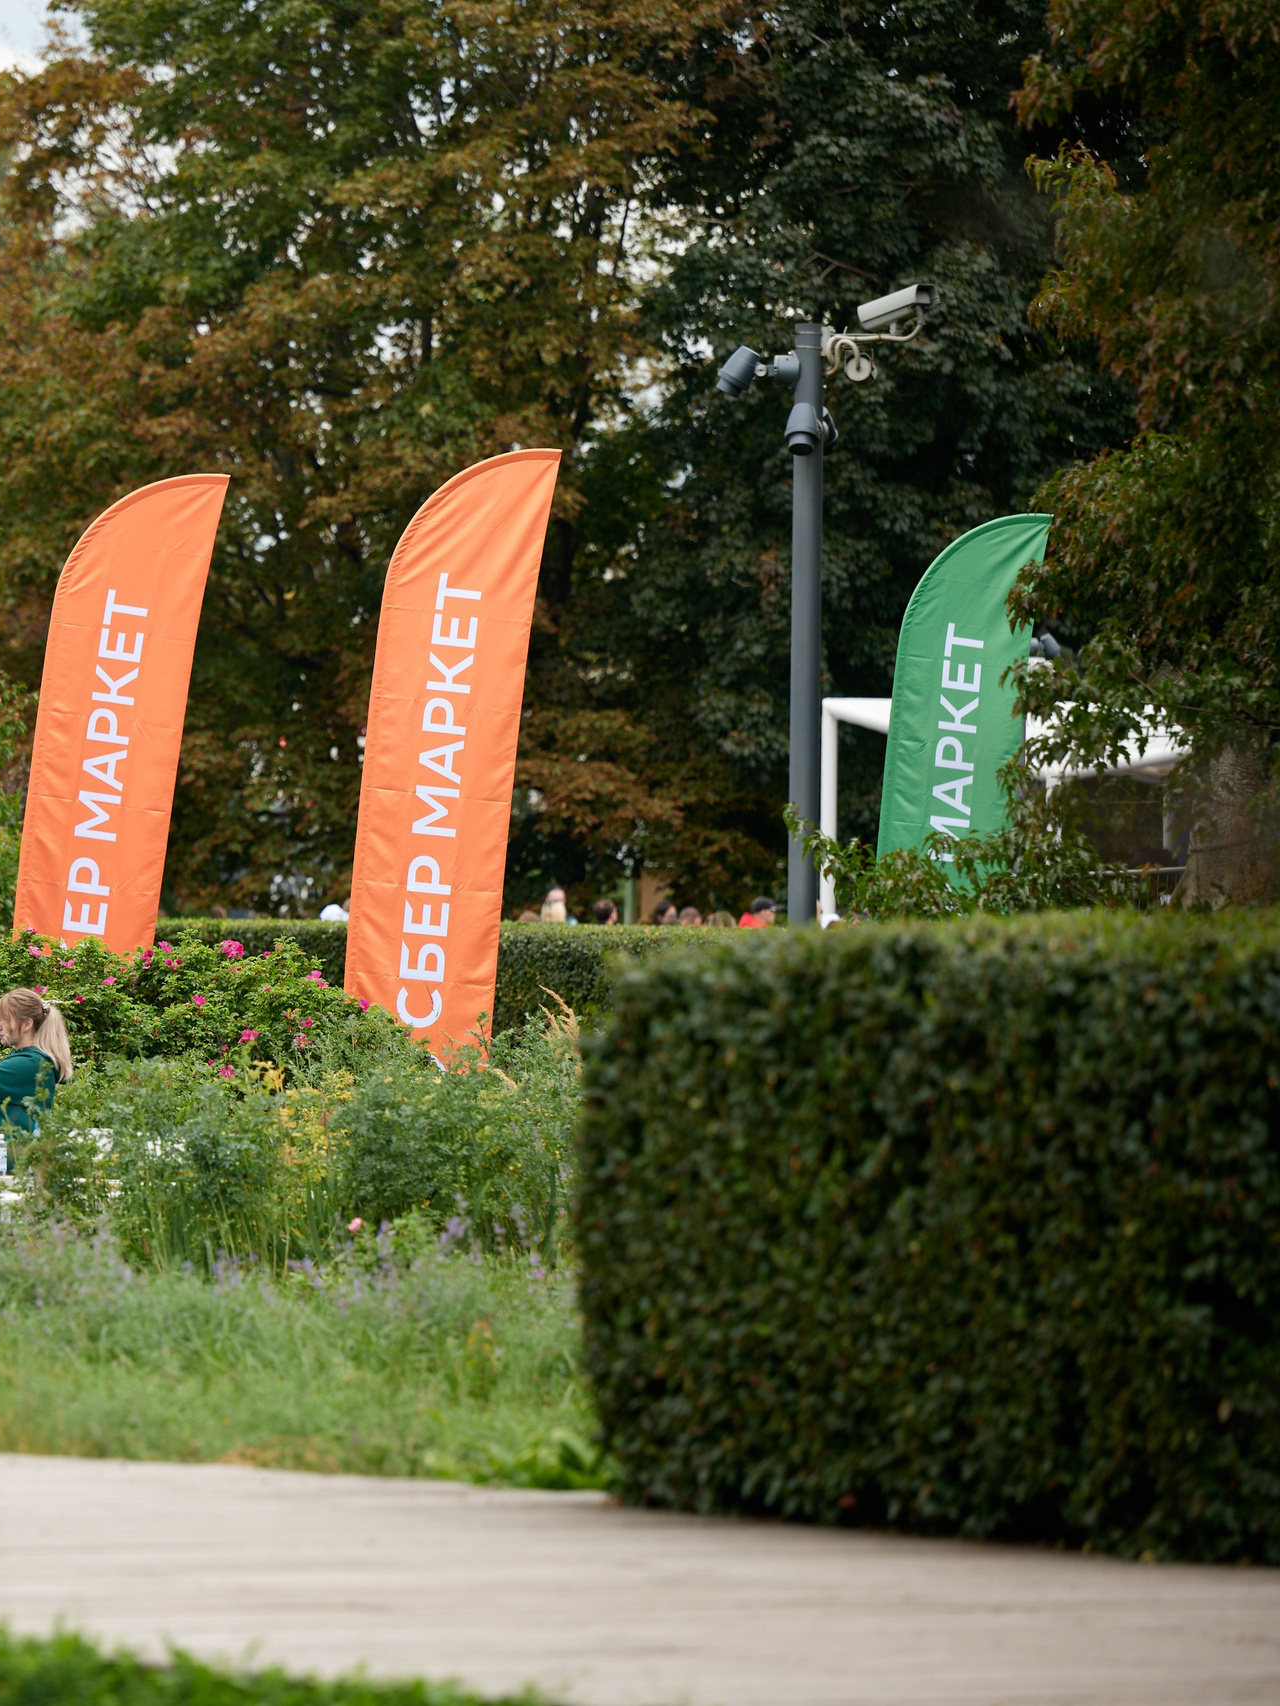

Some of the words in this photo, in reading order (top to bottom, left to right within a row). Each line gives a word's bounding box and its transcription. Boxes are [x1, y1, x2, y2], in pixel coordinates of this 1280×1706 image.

[73, 589, 149, 842] МАРКЕТ
[412, 572, 483, 838] МАРКЕТ
[60, 856, 111, 949] ЕР
[396, 855, 452, 1028] СБЕР
